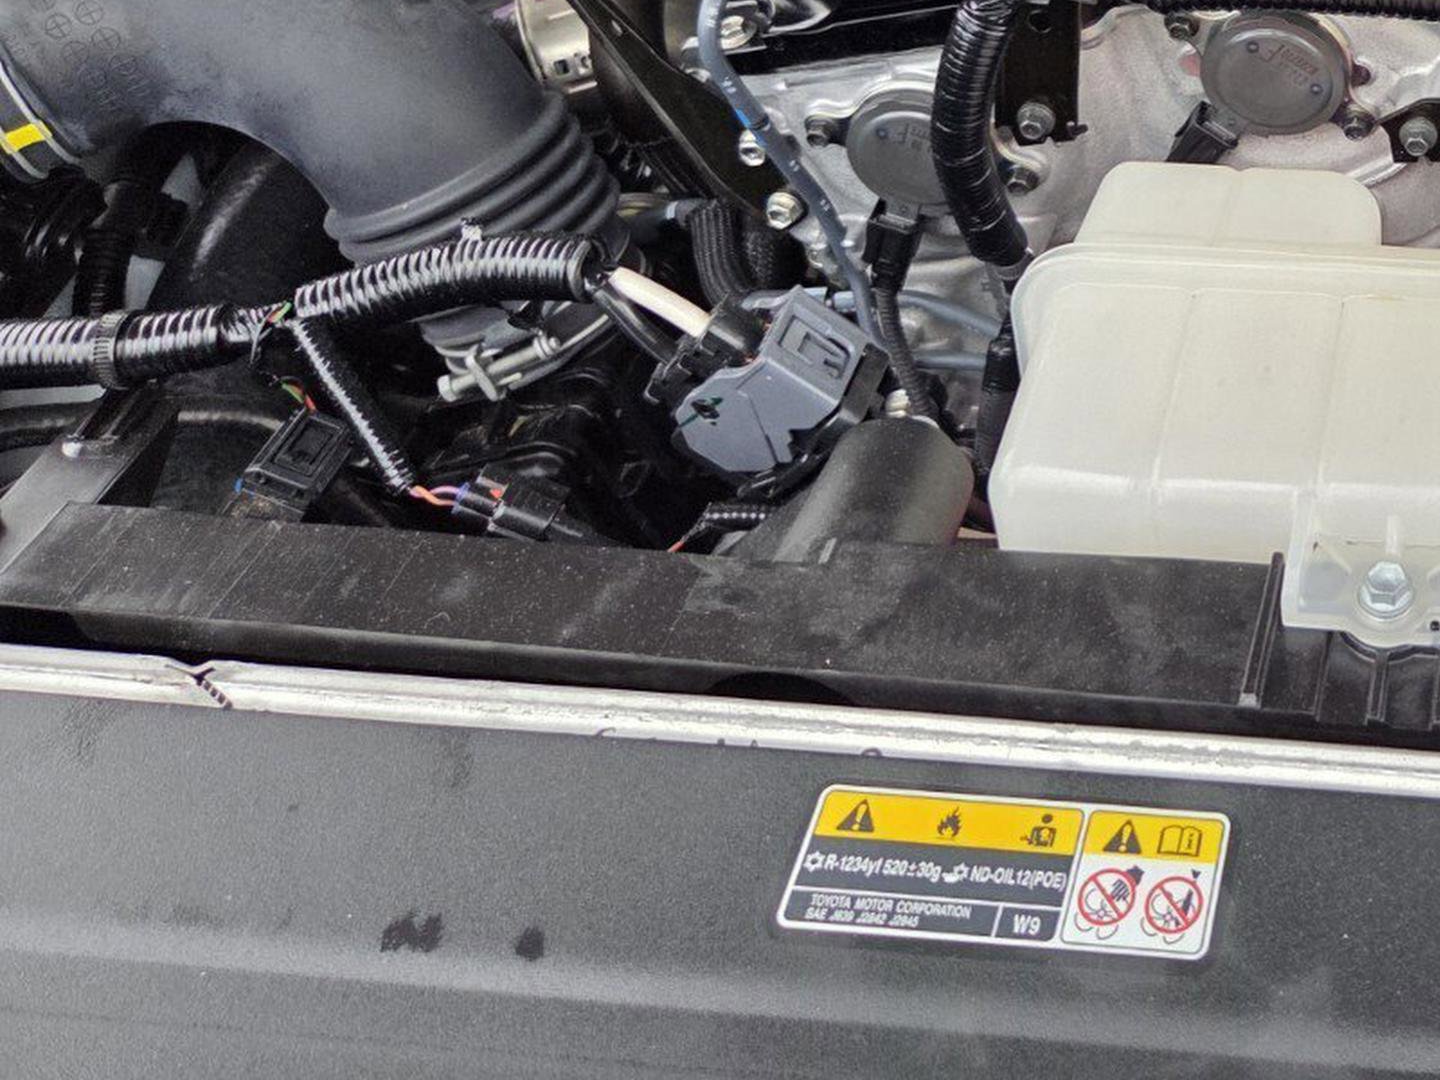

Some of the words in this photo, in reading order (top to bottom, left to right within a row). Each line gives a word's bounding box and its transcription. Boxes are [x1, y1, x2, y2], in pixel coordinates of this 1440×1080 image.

[824, 854, 881, 876] R-1234yf
[805, 907, 828, 919] SAE
[811, 893, 850, 909] TOYOTA
[854, 898, 893, 912] MOTOR
[896, 900, 971, 919] CORPORATION
[1013, 914, 1041, 935] W9
